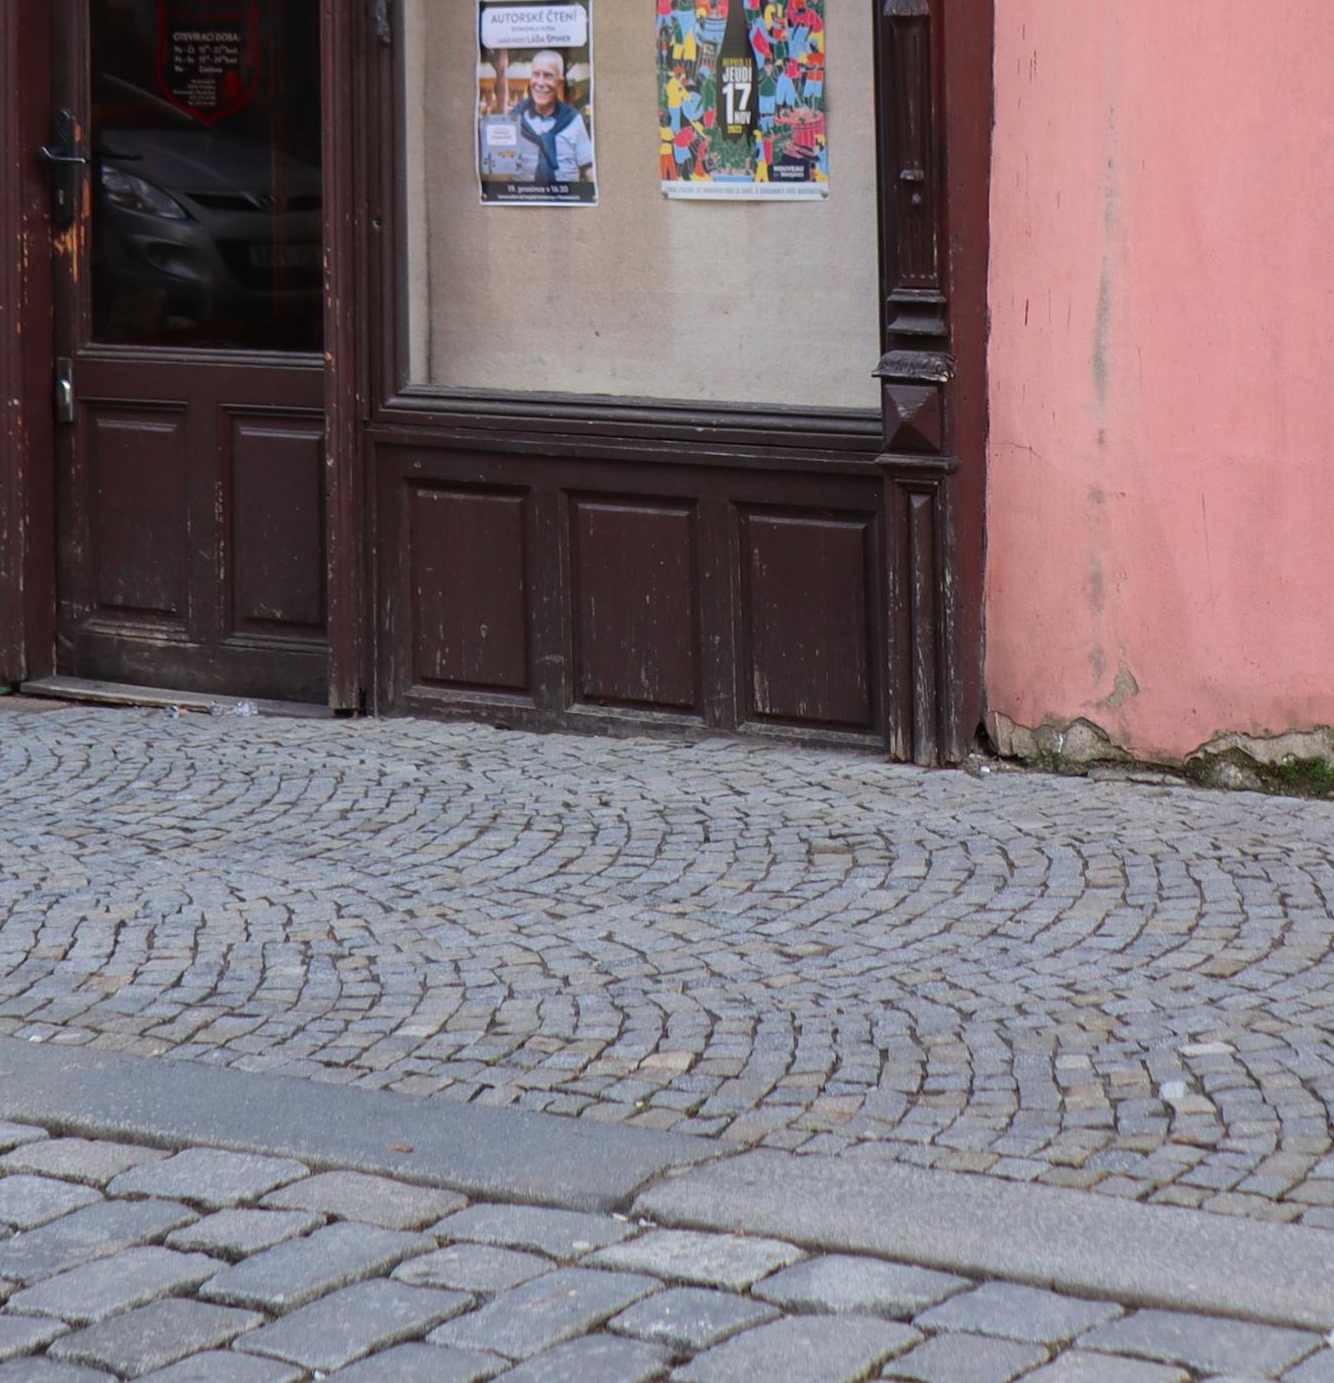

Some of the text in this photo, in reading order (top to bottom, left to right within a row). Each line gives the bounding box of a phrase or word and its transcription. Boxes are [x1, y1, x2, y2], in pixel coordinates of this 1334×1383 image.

[491, 8, 577, 24] AUTORSKÉ ČTENÍ
[722, 66, 753, 83] JEUDI
[722, 82, 752, 124] 17
[734, 110, 752, 124] NOV
